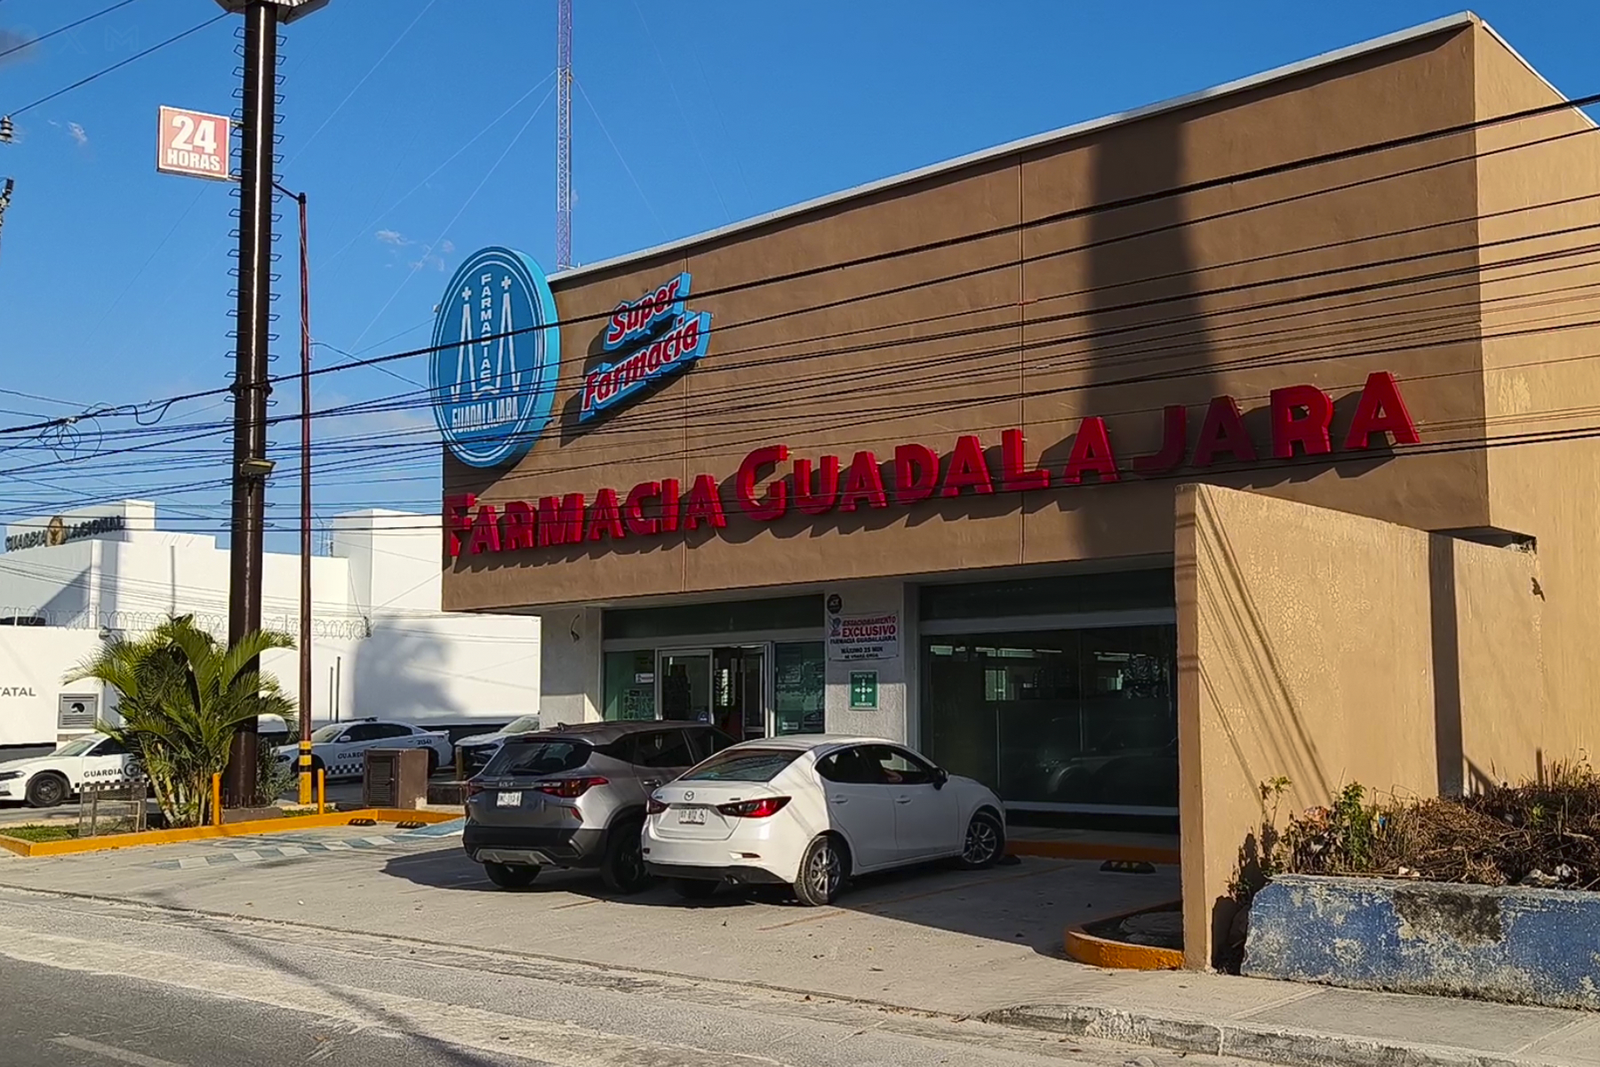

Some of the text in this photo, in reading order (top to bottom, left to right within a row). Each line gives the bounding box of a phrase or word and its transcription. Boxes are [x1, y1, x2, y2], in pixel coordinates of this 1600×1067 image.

[171, 115, 217, 154] 24
[167, 148, 221, 171] HORAS
[480, 273, 492, 383] FARMACIAS
[607, 278, 680, 343] Super
[583, 316, 699, 410] Farmacia
[452, 396, 518, 434] GUADALAJARA
[443, 370, 1420, 557] FARMACIA GUADALAJARA
[842, 625, 896, 638] EXCLUSIVO
[83, 767, 122, 778] GUARDIA
